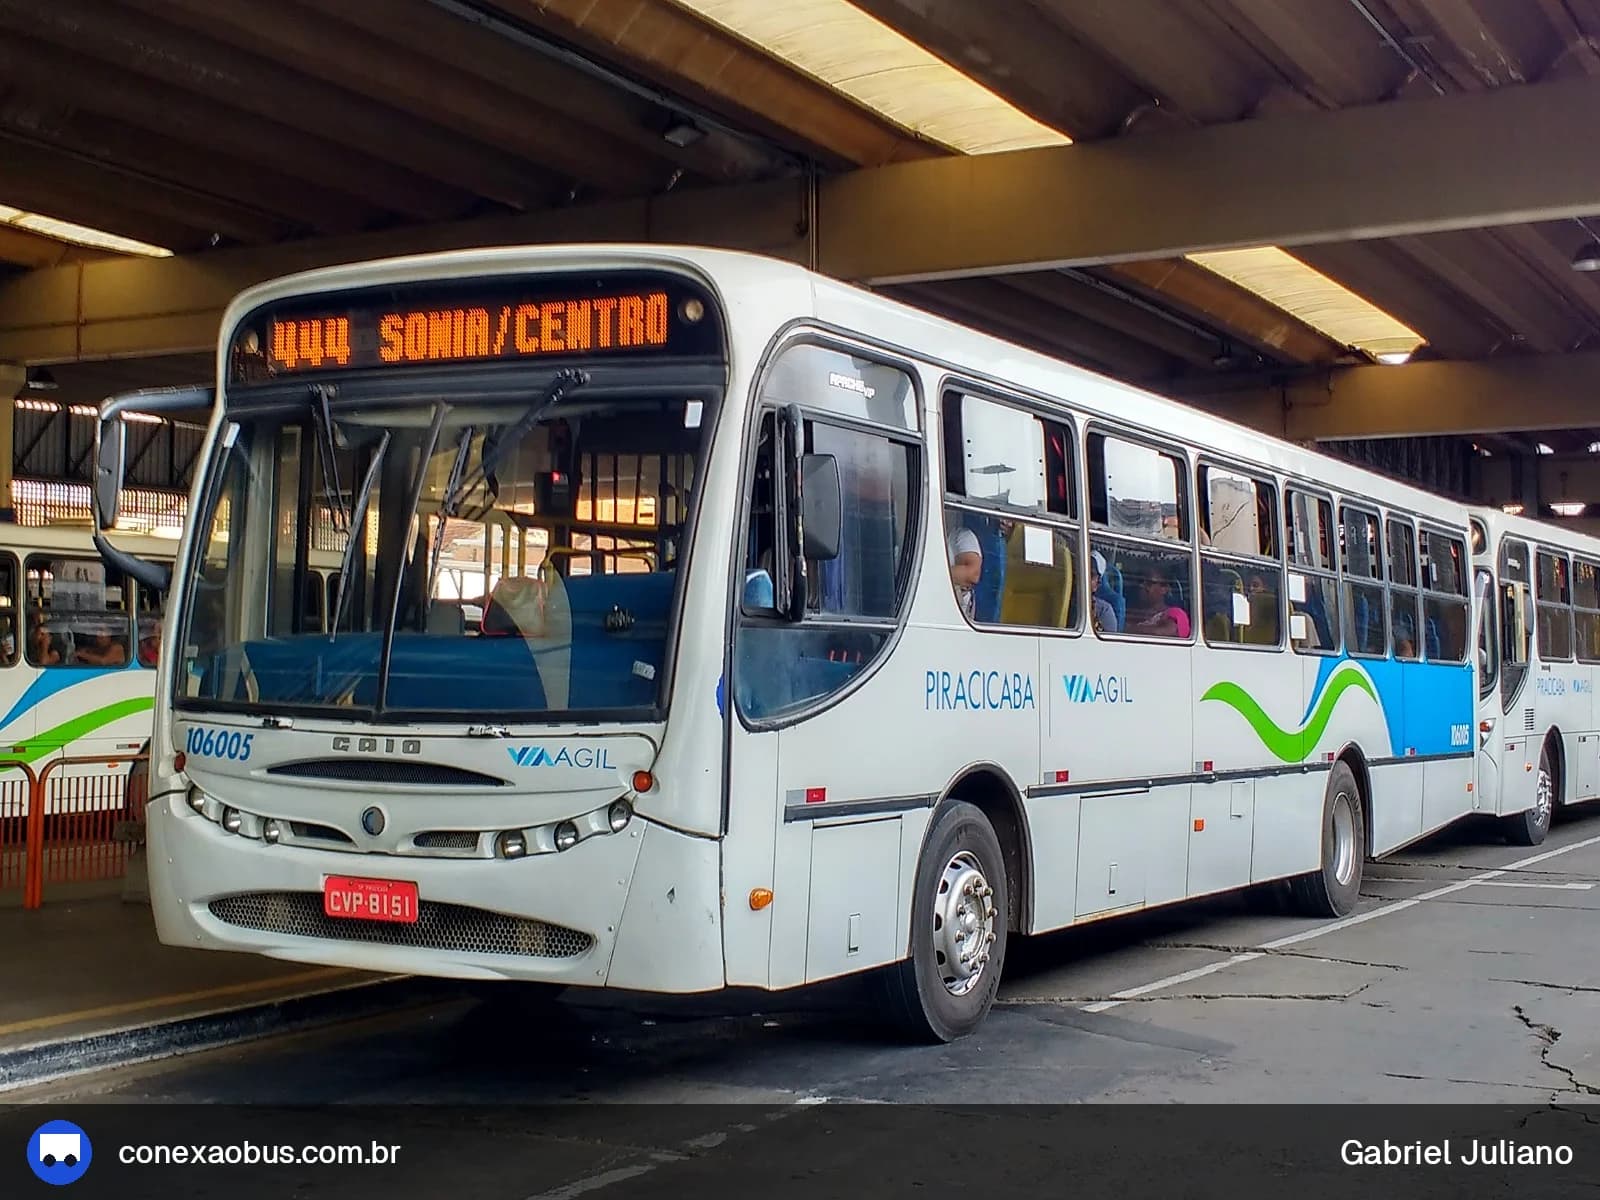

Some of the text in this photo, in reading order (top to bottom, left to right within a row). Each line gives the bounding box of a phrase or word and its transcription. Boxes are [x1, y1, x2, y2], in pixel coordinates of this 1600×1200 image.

[273, 318, 351, 369] 444
[925, 671, 1036, 710] PIRACICABA
[186, 728, 254, 761] 106005
[333, 737, 421, 754] CAIO
